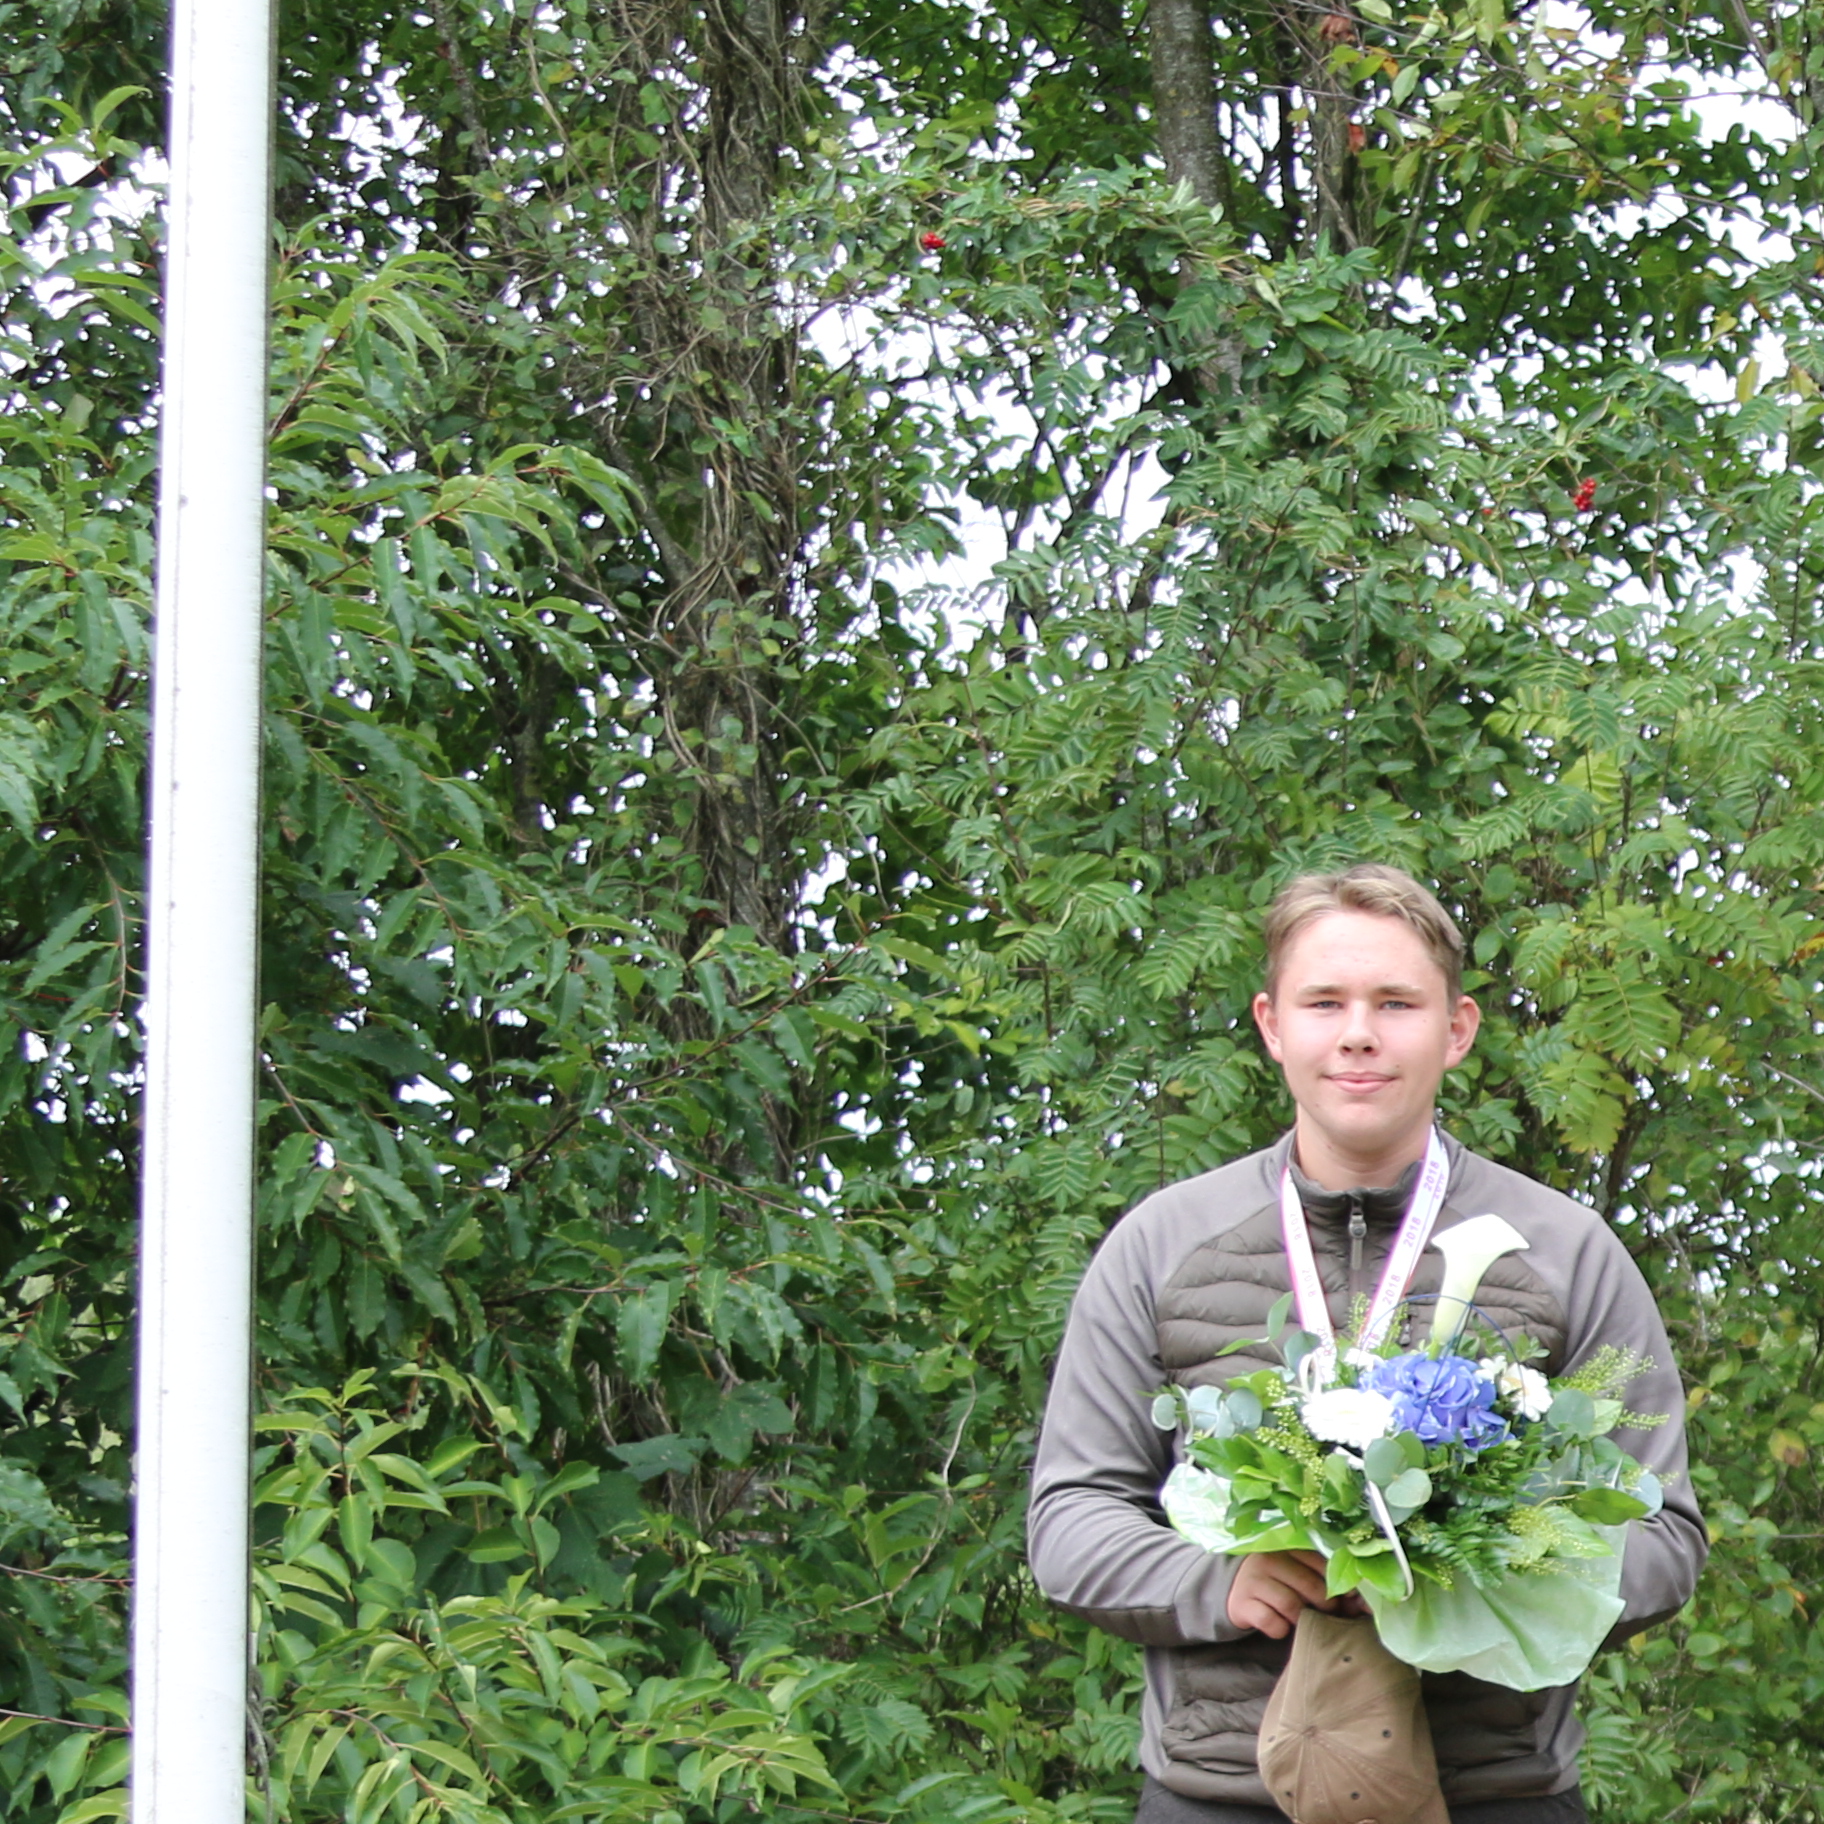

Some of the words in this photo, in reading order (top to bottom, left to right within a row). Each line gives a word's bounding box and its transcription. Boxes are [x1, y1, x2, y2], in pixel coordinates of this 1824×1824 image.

[1424, 1160, 1440, 1192] 2018
[1290, 1212, 1302, 1240] 2018
[1403, 1217, 1421, 1248] 2018
[1302, 1268, 1317, 1297] 2018
[1382, 1274, 1401, 1306] 2018
